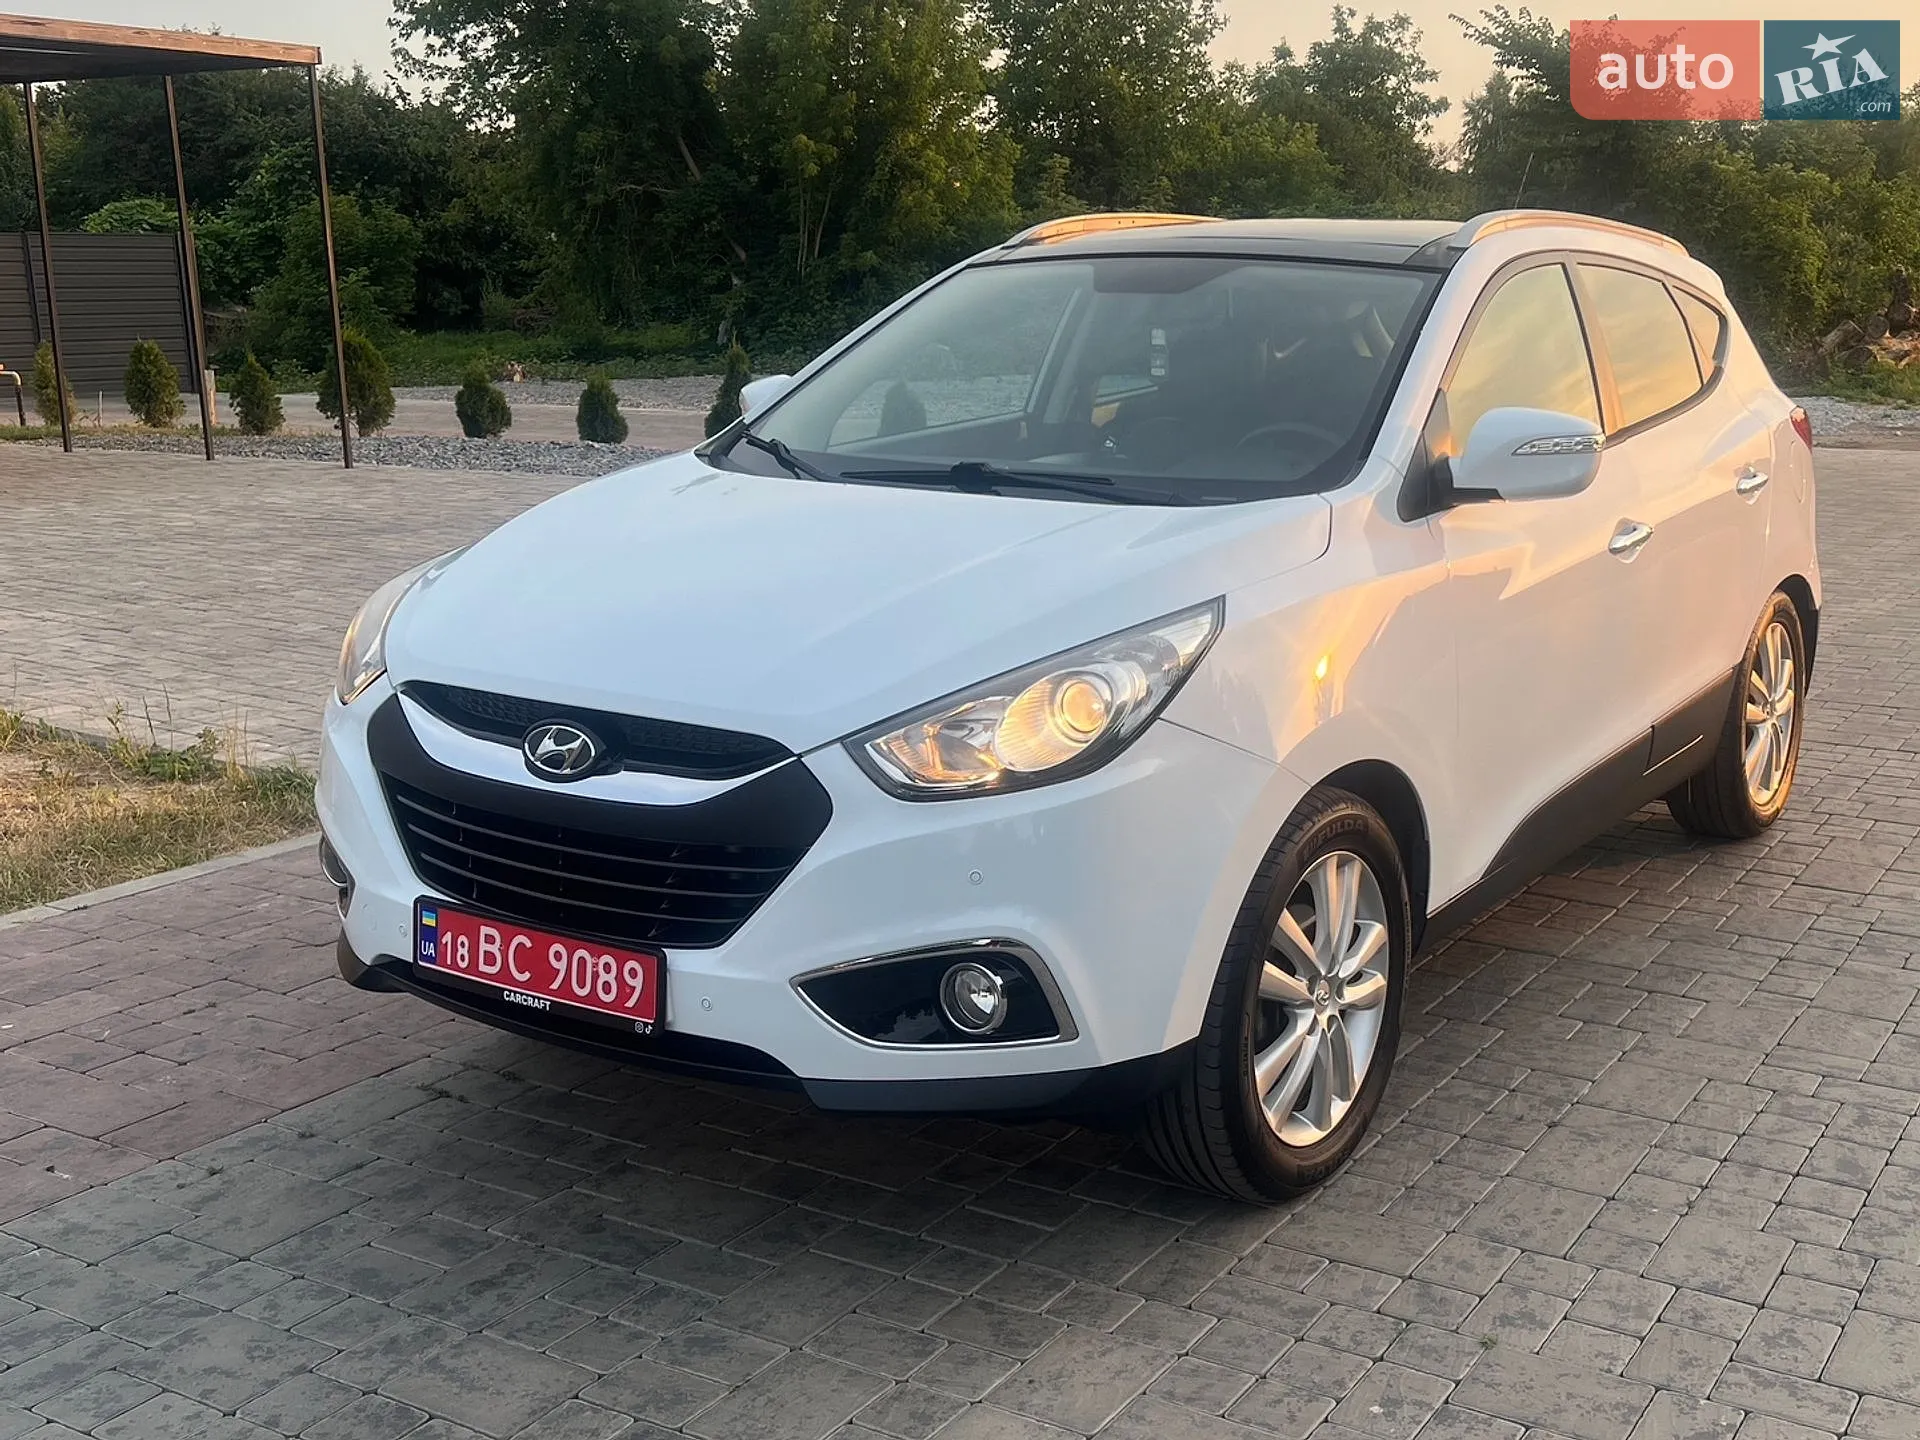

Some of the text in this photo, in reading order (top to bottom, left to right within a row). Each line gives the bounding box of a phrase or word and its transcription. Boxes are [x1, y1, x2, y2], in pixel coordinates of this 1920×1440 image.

[421, 940, 435, 958] UA
[441, 925, 644, 1008] 18 BC 9089
[503, 990, 551, 1011] CARCRAFT
